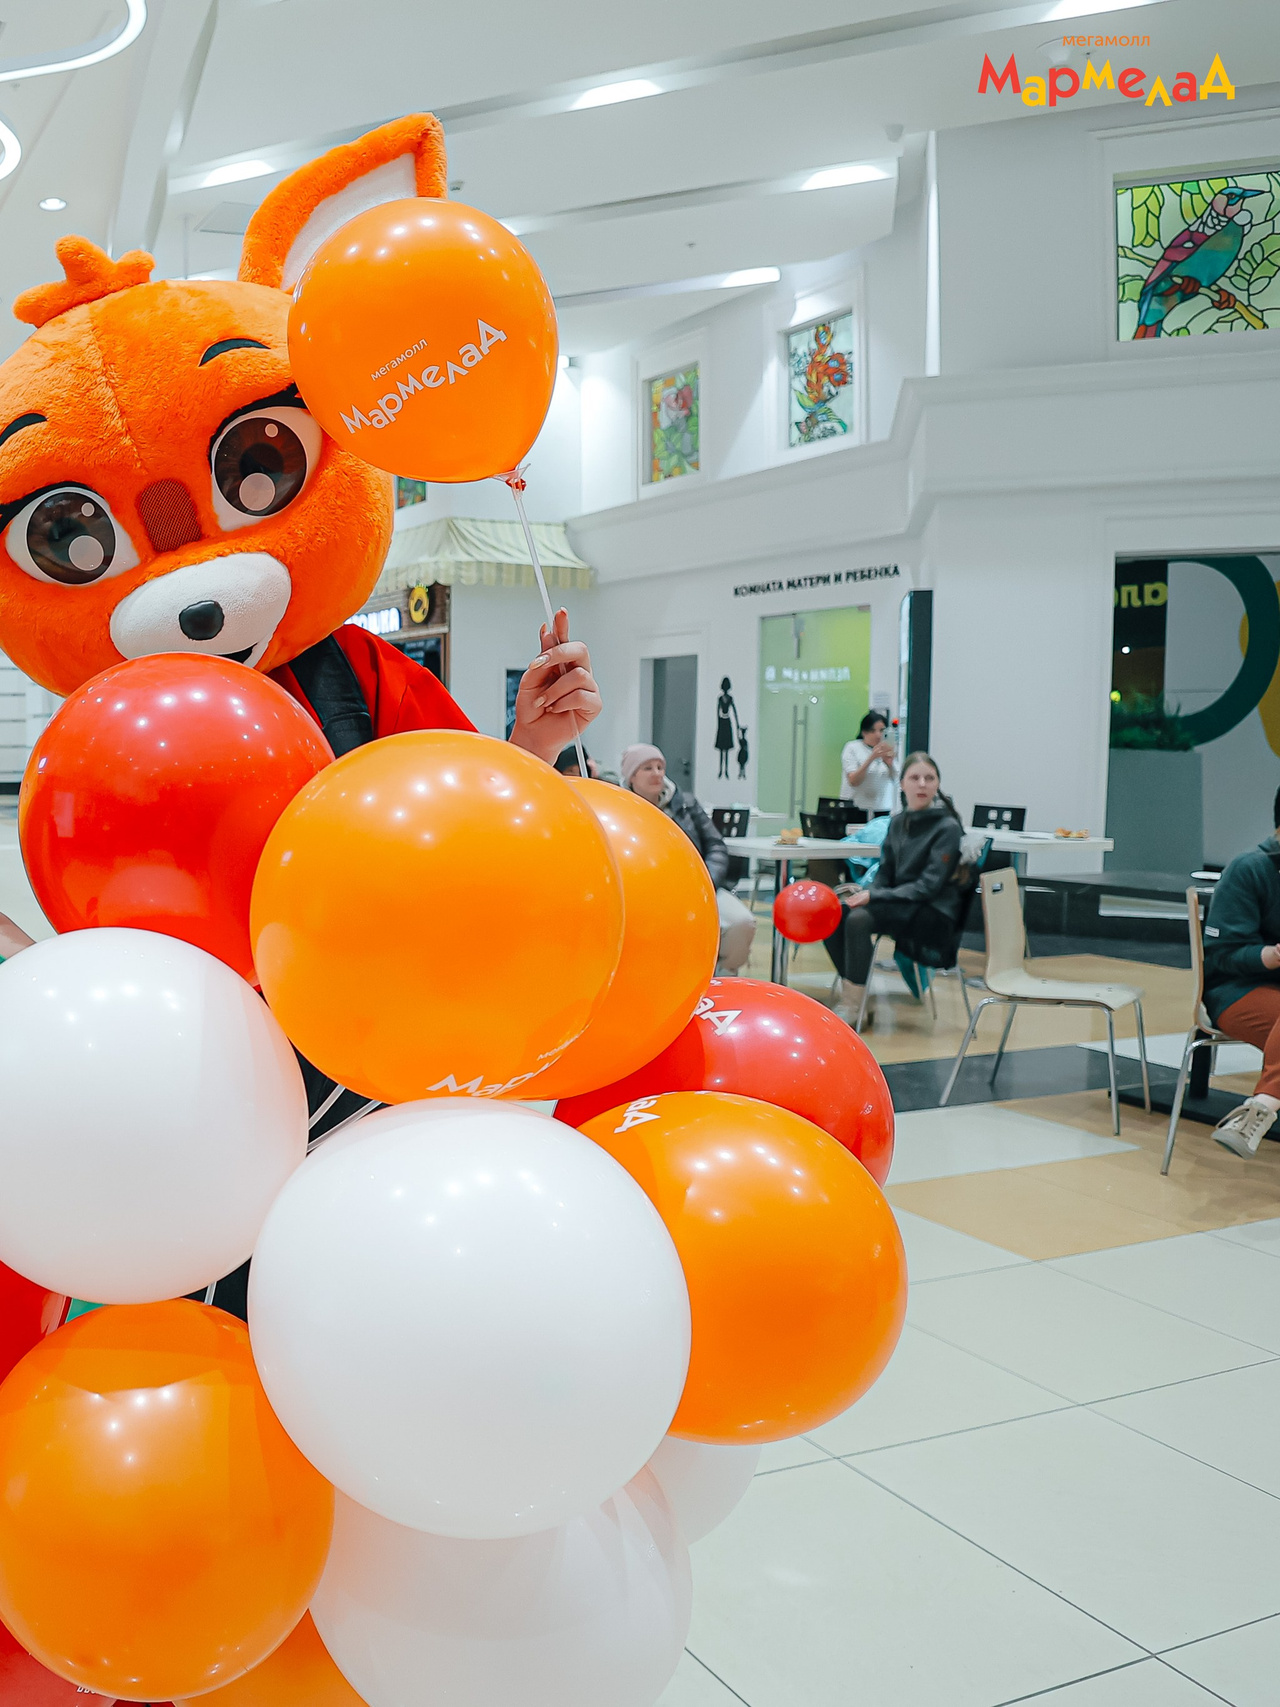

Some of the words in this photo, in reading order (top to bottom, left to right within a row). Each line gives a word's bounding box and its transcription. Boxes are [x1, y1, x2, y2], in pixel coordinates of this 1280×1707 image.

[370, 338, 428, 381] мегамолл
[733, 581, 784, 598] КОМНАТА
[786, 573, 831, 590] МАТЕРИ
[834, 571, 842, 584] И
